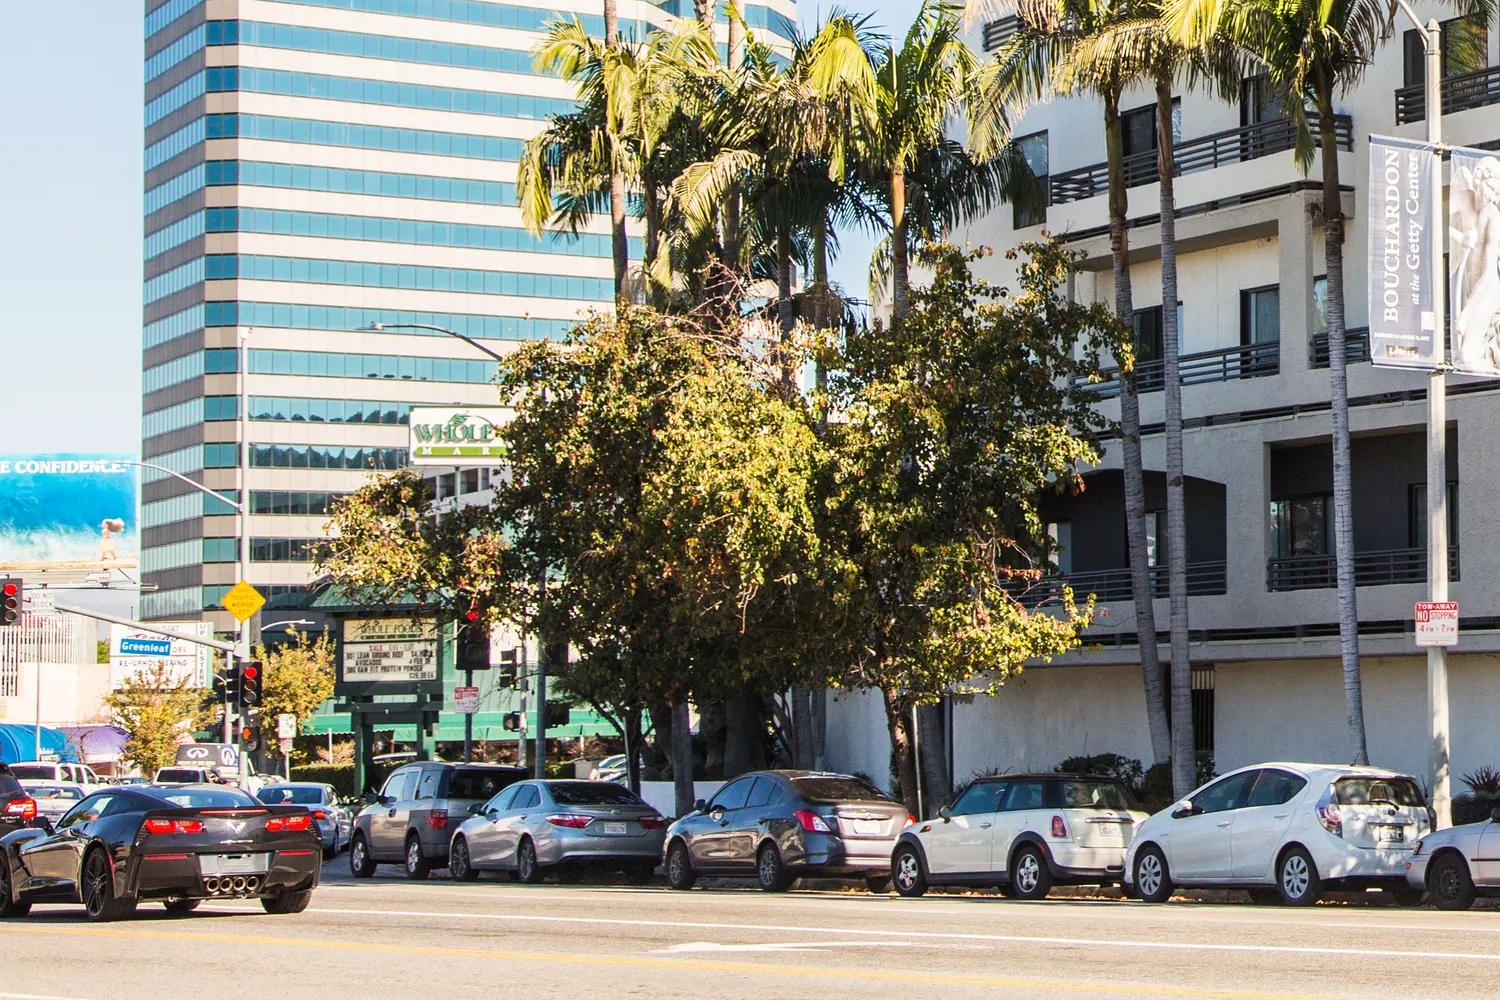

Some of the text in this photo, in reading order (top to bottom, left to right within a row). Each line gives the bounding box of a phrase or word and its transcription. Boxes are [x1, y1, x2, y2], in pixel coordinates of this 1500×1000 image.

[1384, 148, 1400, 323] BOUCHARDON
[1406, 152, 1423, 305] at the Getty Center
[414, 423, 493, 442] WHOLE
[1417, 610, 1429, 622] NO
[121, 641, 170, 653] Greenleaf
